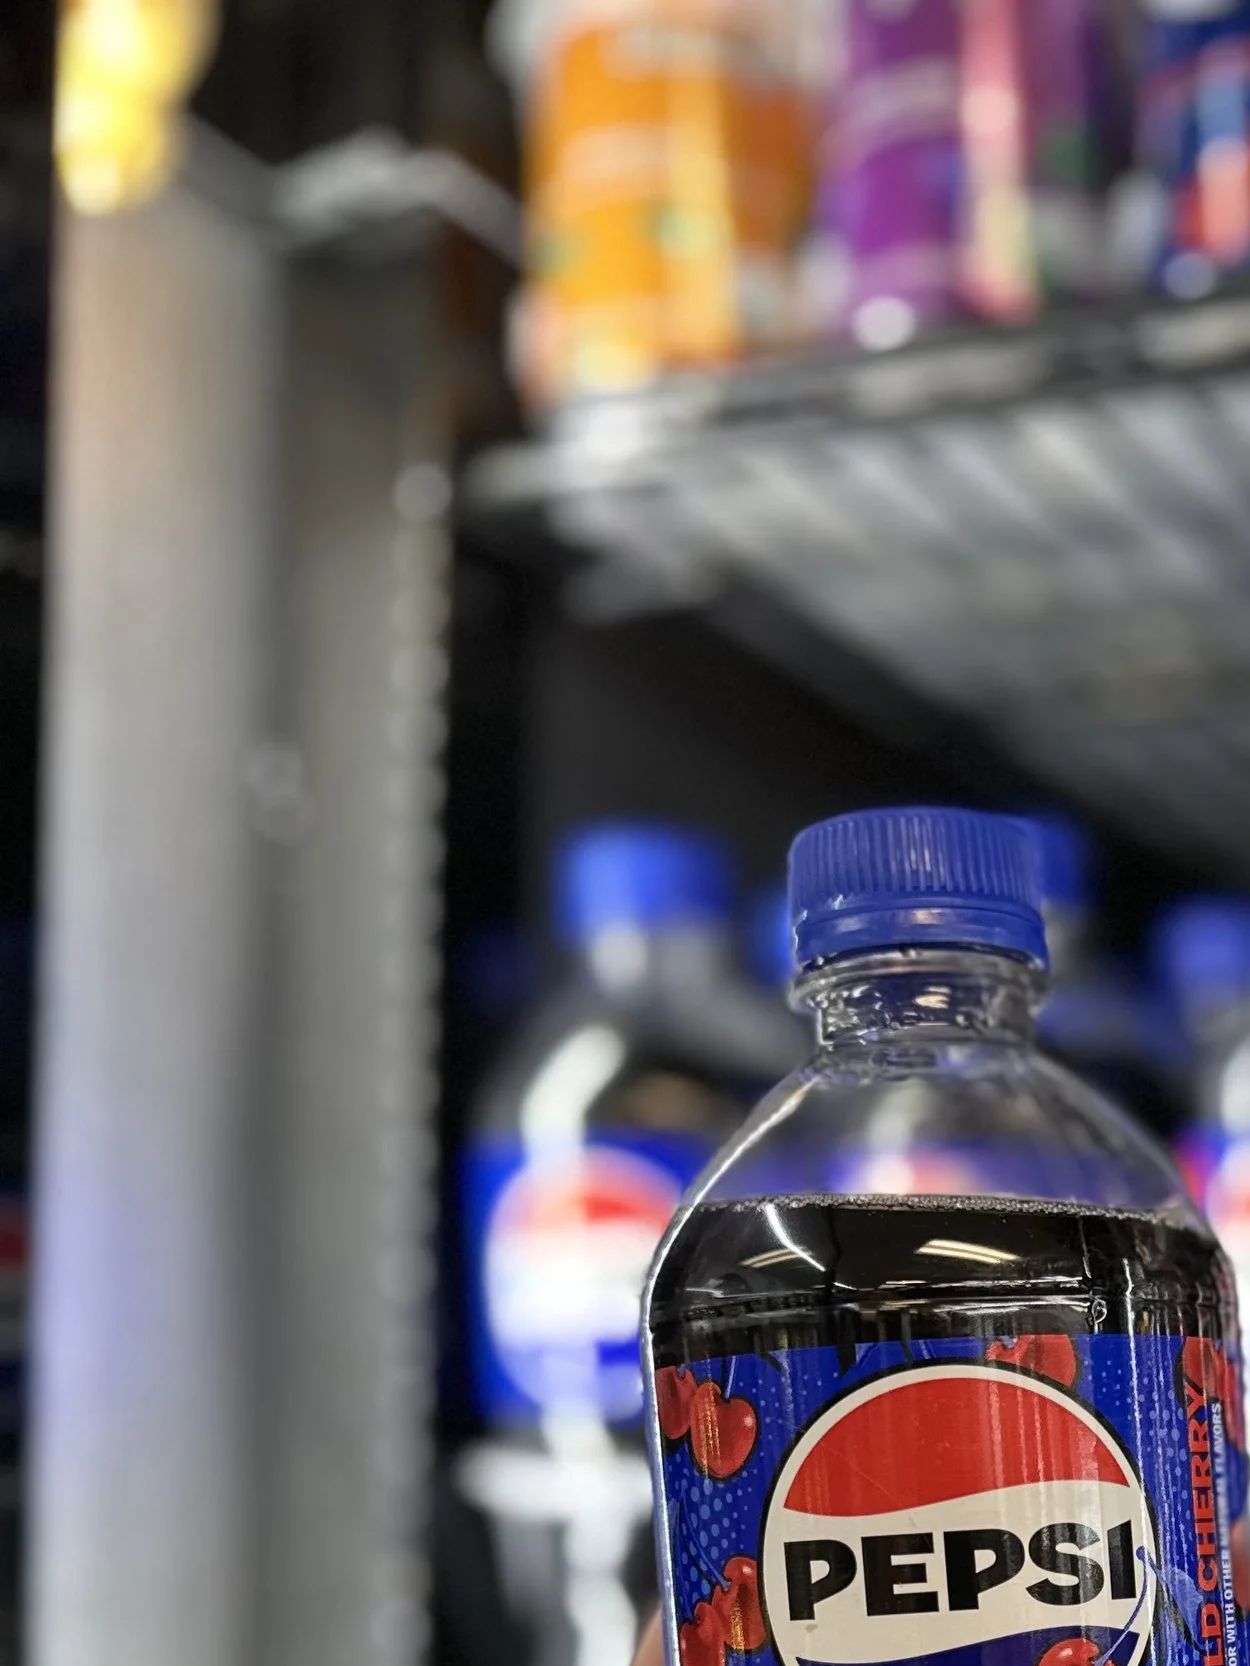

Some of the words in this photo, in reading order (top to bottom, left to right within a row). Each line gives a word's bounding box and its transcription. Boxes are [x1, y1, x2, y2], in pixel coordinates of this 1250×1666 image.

[1210, 1402, 1228, 1474] FLAVORS
[1183, 1380, 1218, 1592] CHERRY
[783, 1518, 1138, 1622] PEPSI
[1220, 1550, 1233, 1599] OTHER
[1224, 1602, 1237, 1643] WITH
